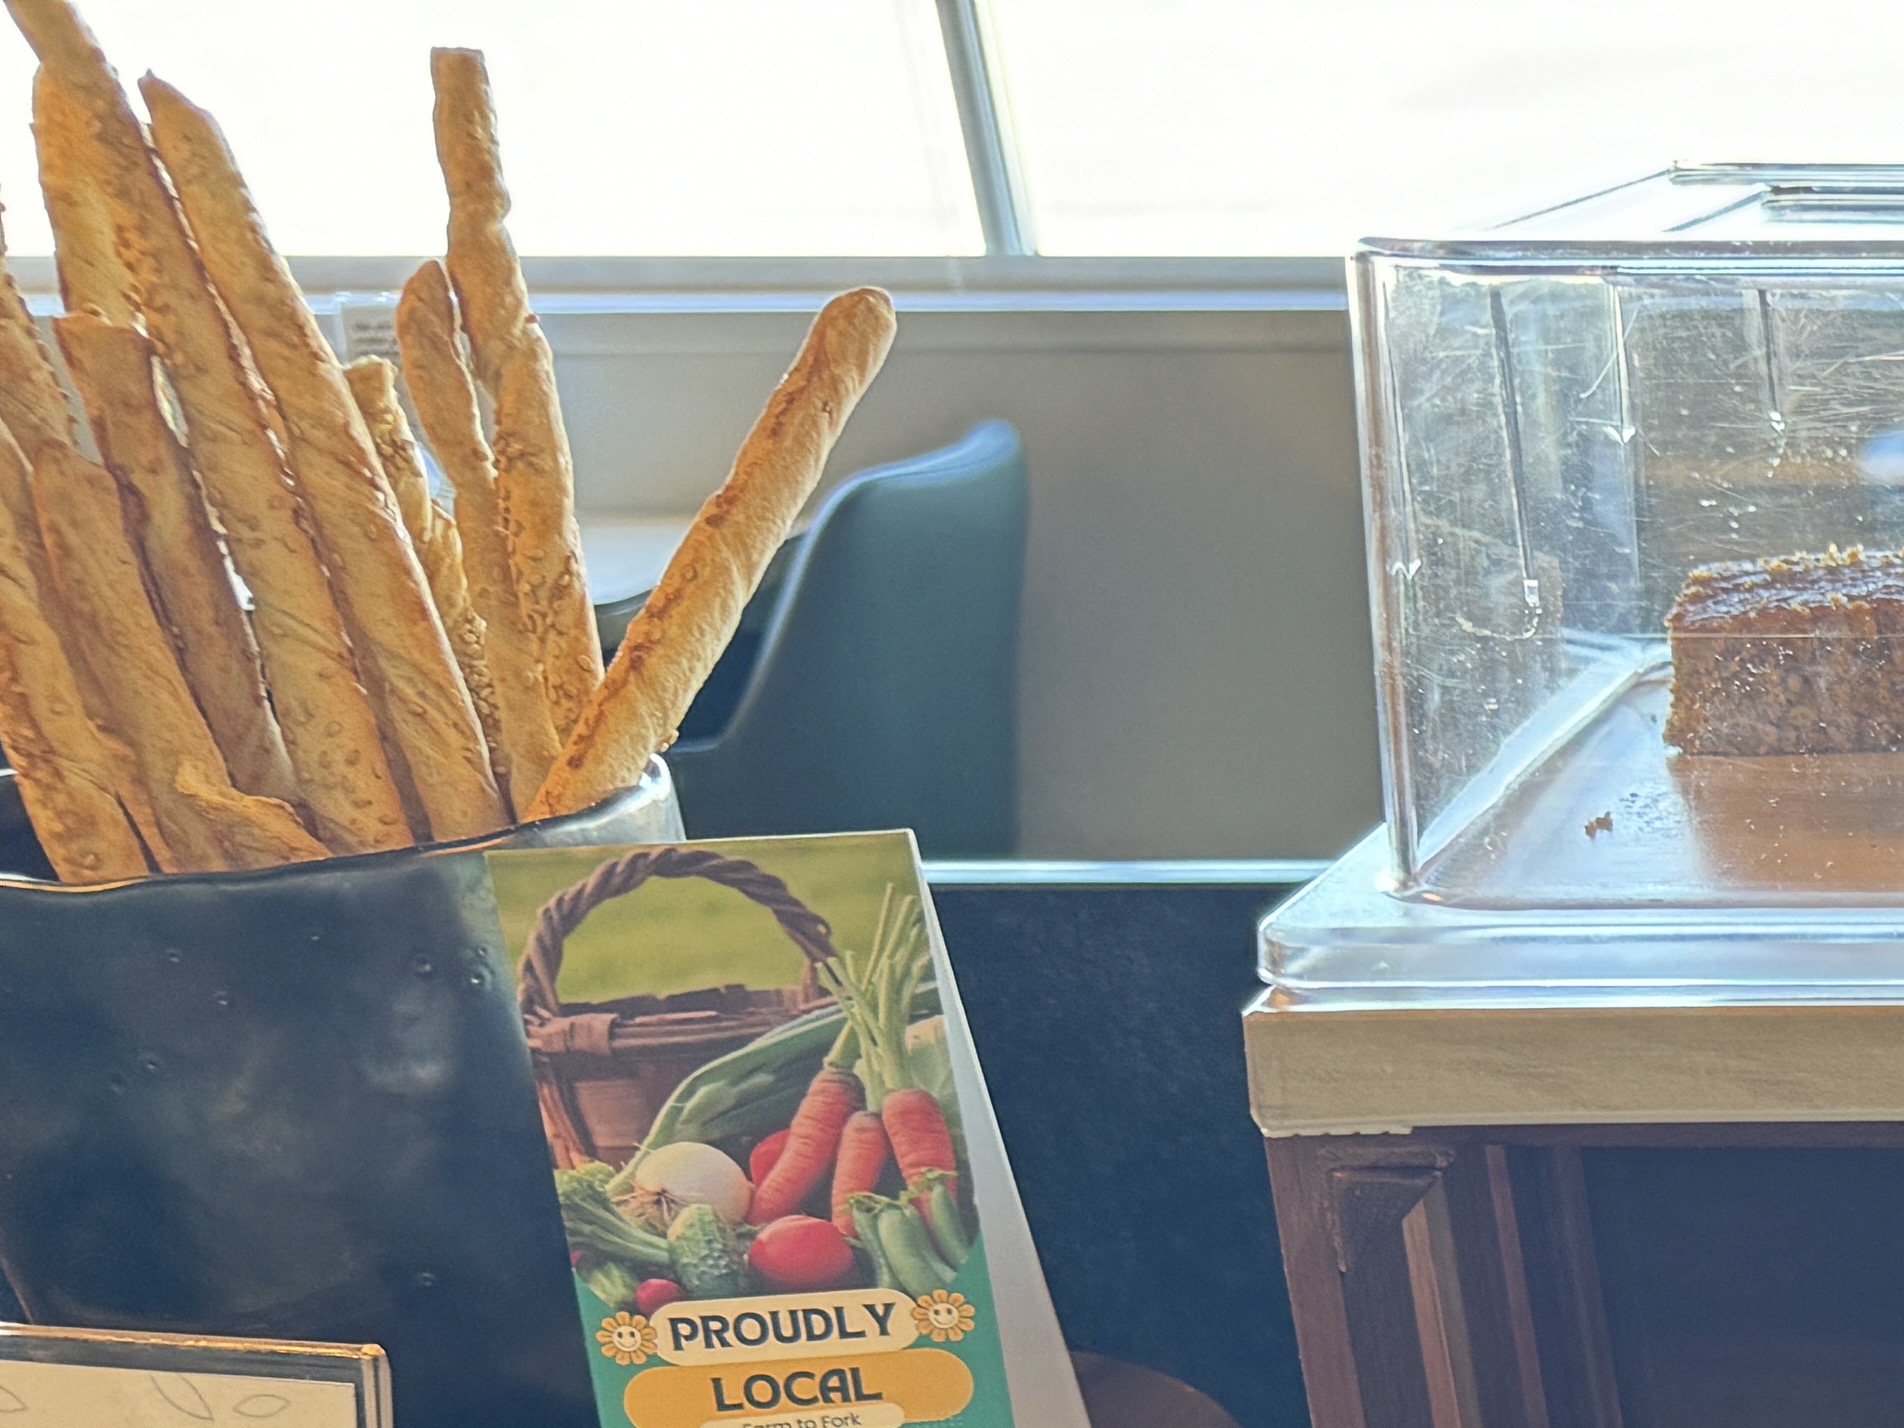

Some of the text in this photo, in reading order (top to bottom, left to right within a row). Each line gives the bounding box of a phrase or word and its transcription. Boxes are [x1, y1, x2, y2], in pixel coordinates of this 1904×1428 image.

[667, 1302, 897, 1352] PROUDLY
[710, 1366, 884, 1412] LOCAL
[822, 1412, 863, 1428] Fork
